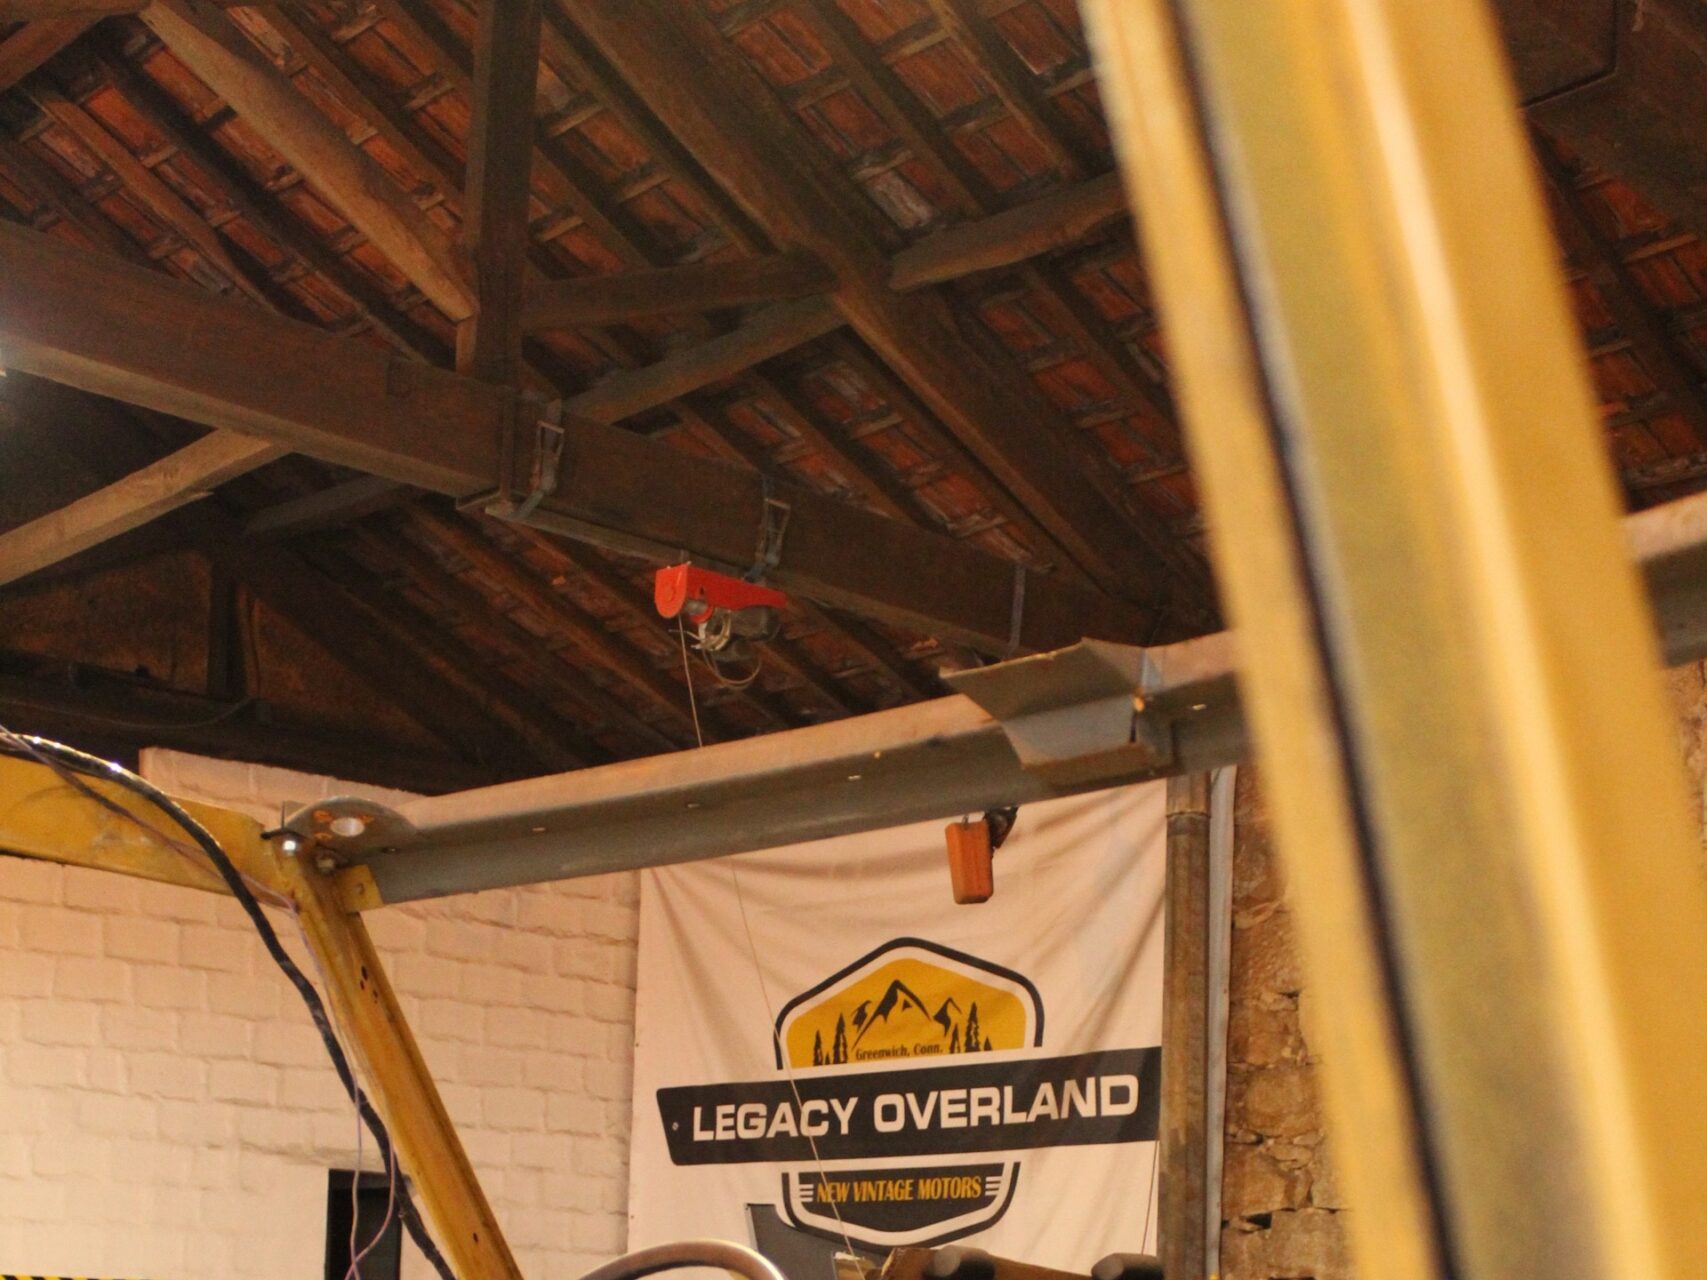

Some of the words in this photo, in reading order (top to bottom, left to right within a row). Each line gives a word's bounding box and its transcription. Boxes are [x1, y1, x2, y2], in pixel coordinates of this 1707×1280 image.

[855, 1045, 910, 1061] Greenwich,
[913, 1042, 943, 1055] Conn.
[693, 1096, 858, 1141] LEGACY
[873, 1074, 1138, 1133] OVERLAND
[816, 1182, 849, 1203] NEW
[853, 1178, 914, 1202] VINTAGE
[918, 1175, 982, 1200] MOTORS
